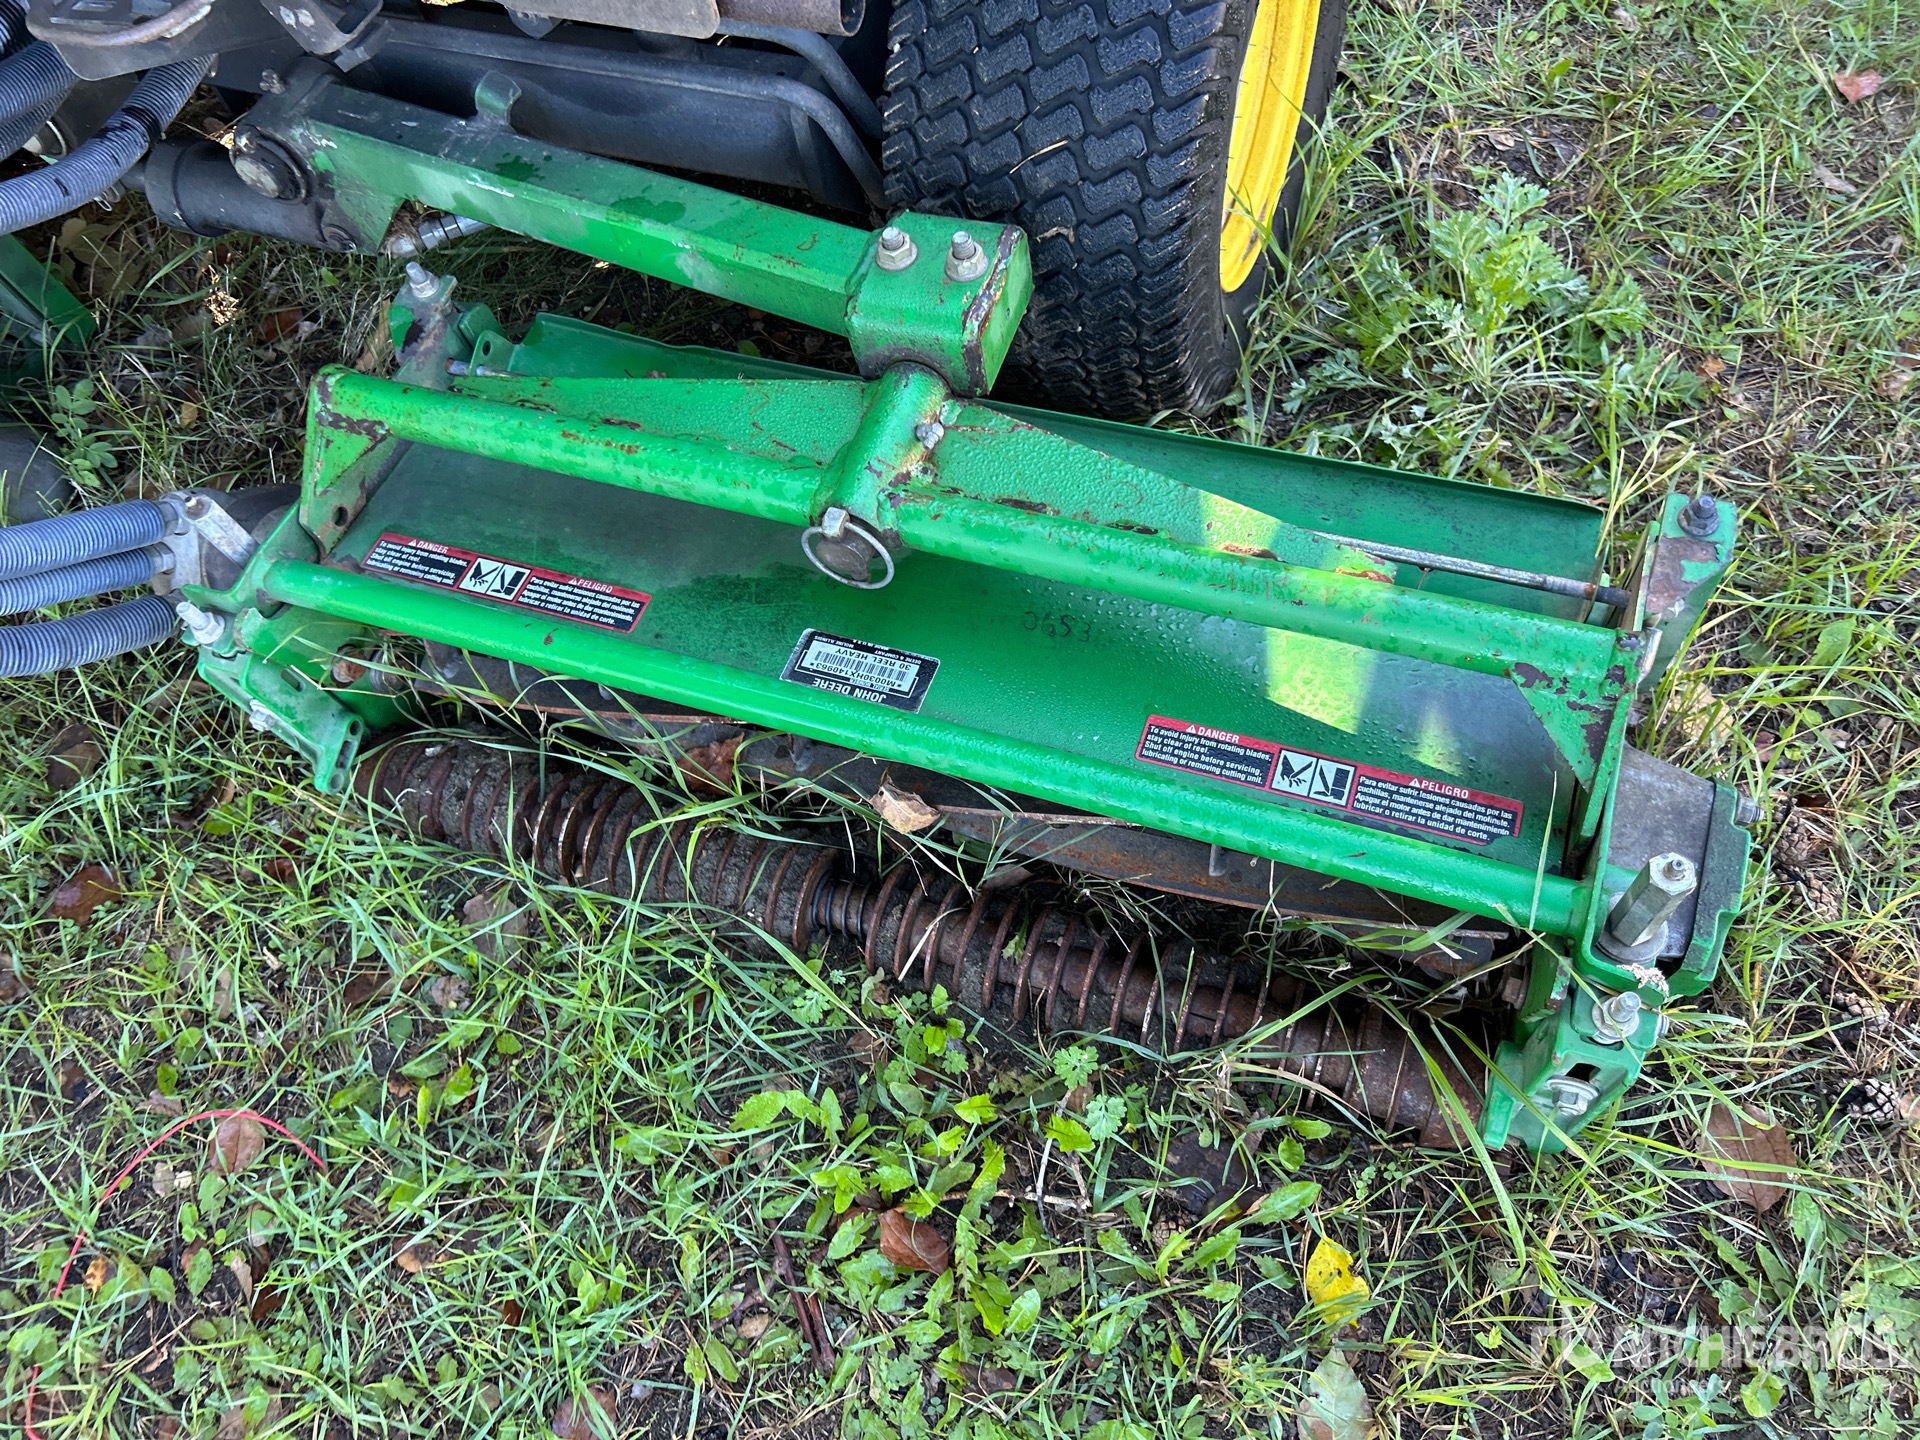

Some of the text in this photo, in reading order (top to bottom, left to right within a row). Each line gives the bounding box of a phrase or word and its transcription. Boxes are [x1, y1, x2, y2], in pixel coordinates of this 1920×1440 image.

[417, 541, 449, 554] DANGER
[577, 580, 613, 593] PELIGRO
[835, 648, 868, 661] HEAVY
[872, 656, 896, 666] REEL
[875, 650, 899, 659] COMPANY
[813, 678, 850, 694] DEERE
[853, 689, 886, 703] JOHN
[1147, 734, 1162, 743] stay
[1163, 737, 1183, 747] clear
[1192, 745, 1210, 754] reel.
[1160, 729, 1179, 738] avoid
[1180, 732, 1200, 743] injury
[1200, 737, 1217, 747] from
[1217, 741, 1245, 755] rotating
[1198, 727, 1240, 743] DANGER
[1145, 741, 1161, 750] Shut
[1174, 748, 1199, 759] engine
[1200, 754, 1224, 766] before
[1142, 749, 1178, 764] lubricating
[1188, 760, 1221, 774] removing
[1221, 768, 1246, 781] cutting
[1247, 775, 1263, 784] unit.
[1360, 777, 1512, 820] Para evitar sufrir lesiones causadas por las
[1422, 780, 1469, 799] PELIGRO
[1356, 792, 1380, 806] Apagar
[1382, 799, 1389, 807] el
[1390, 802, 1410, 813] motor
[1411, 806, 1431, 817] antes
[1432, 812, 1441, 820] de
[1442, 814, 1455, 822] dar
[1392, 793, 1434, 809] mantenerse
[1435, 803, 1462, 816] alejado
[1463, 810, 1475, 819] del
[1354, 801, 1383, 814] lubricar
[1392, 811, 1419, 822] retirar
[1418, 816, 1426, 824] la
[1427, 819, 1454, 832] unidad
[1455, 825, 1466, 834] de
[1467, 830, 1490, 841] corte.
